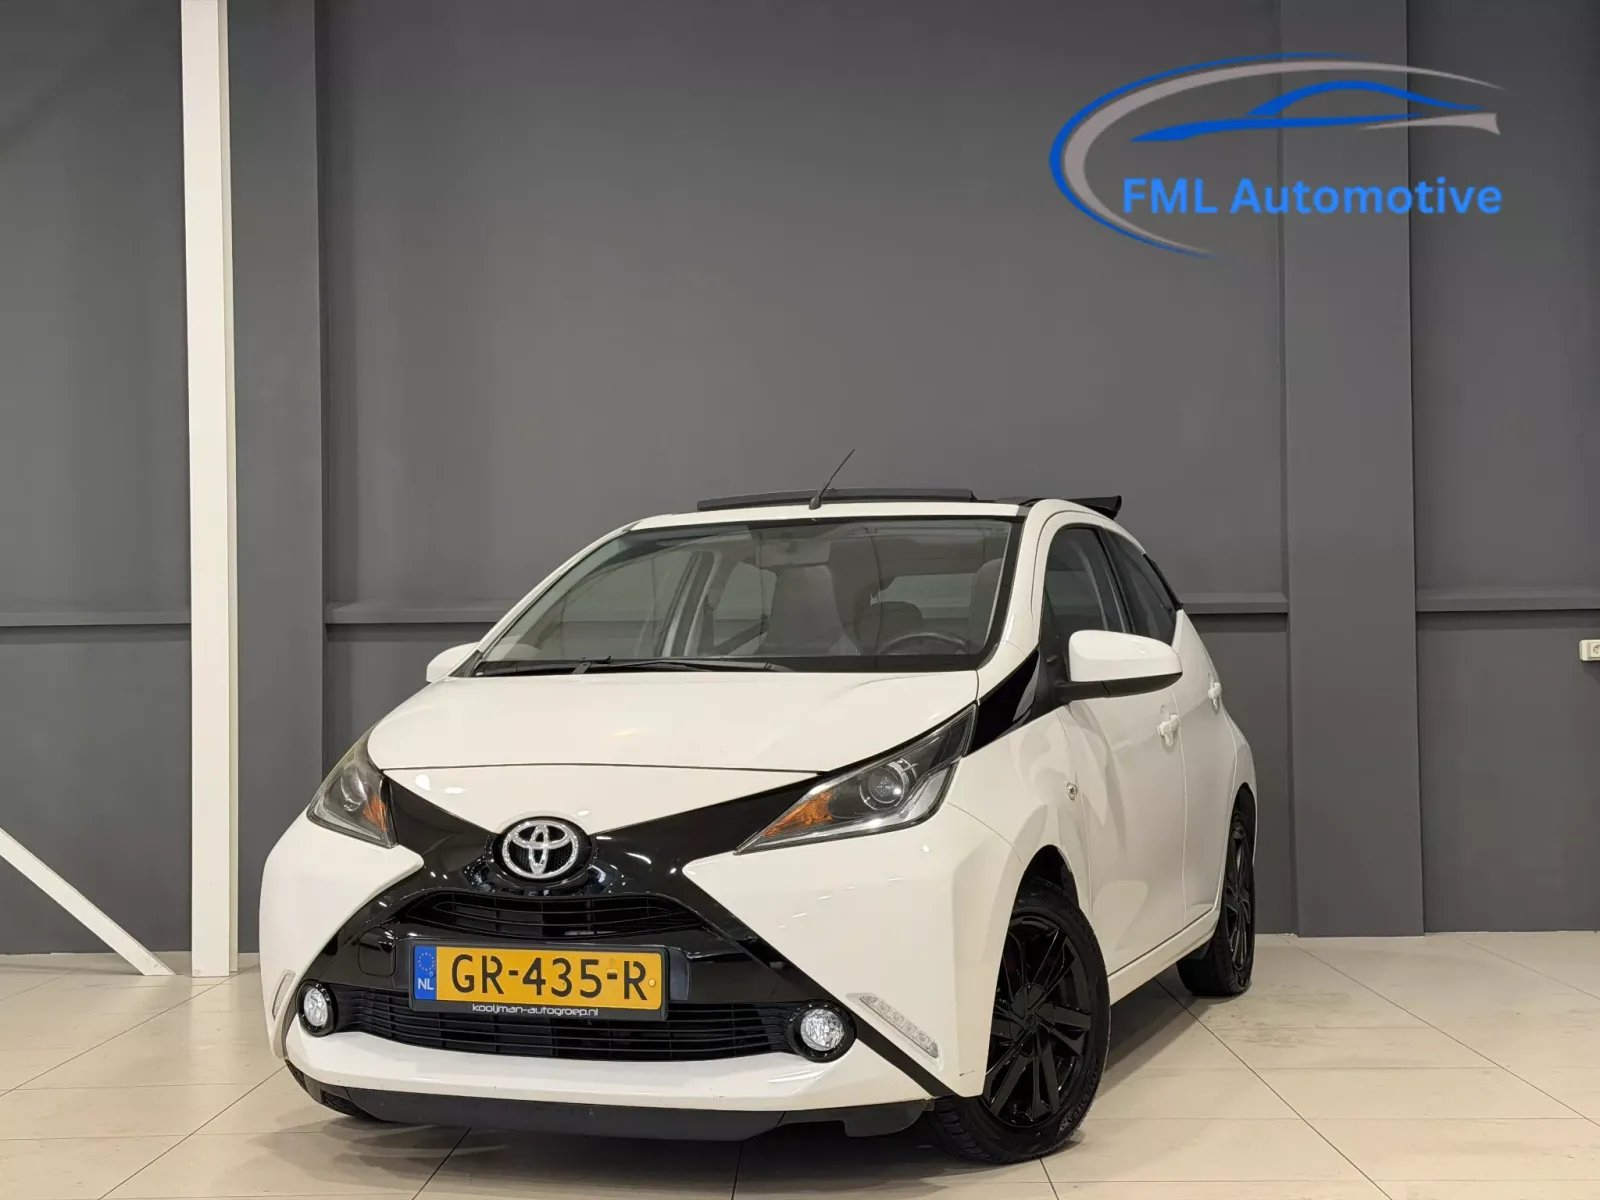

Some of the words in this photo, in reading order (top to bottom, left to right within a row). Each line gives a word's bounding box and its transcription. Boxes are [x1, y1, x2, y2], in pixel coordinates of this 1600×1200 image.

[418, 978, 434, 991] NL
[451, 954, 648, 1001] GR-435-R
[472, 1003, 599, 1017] kooijman-autogroep.nl
